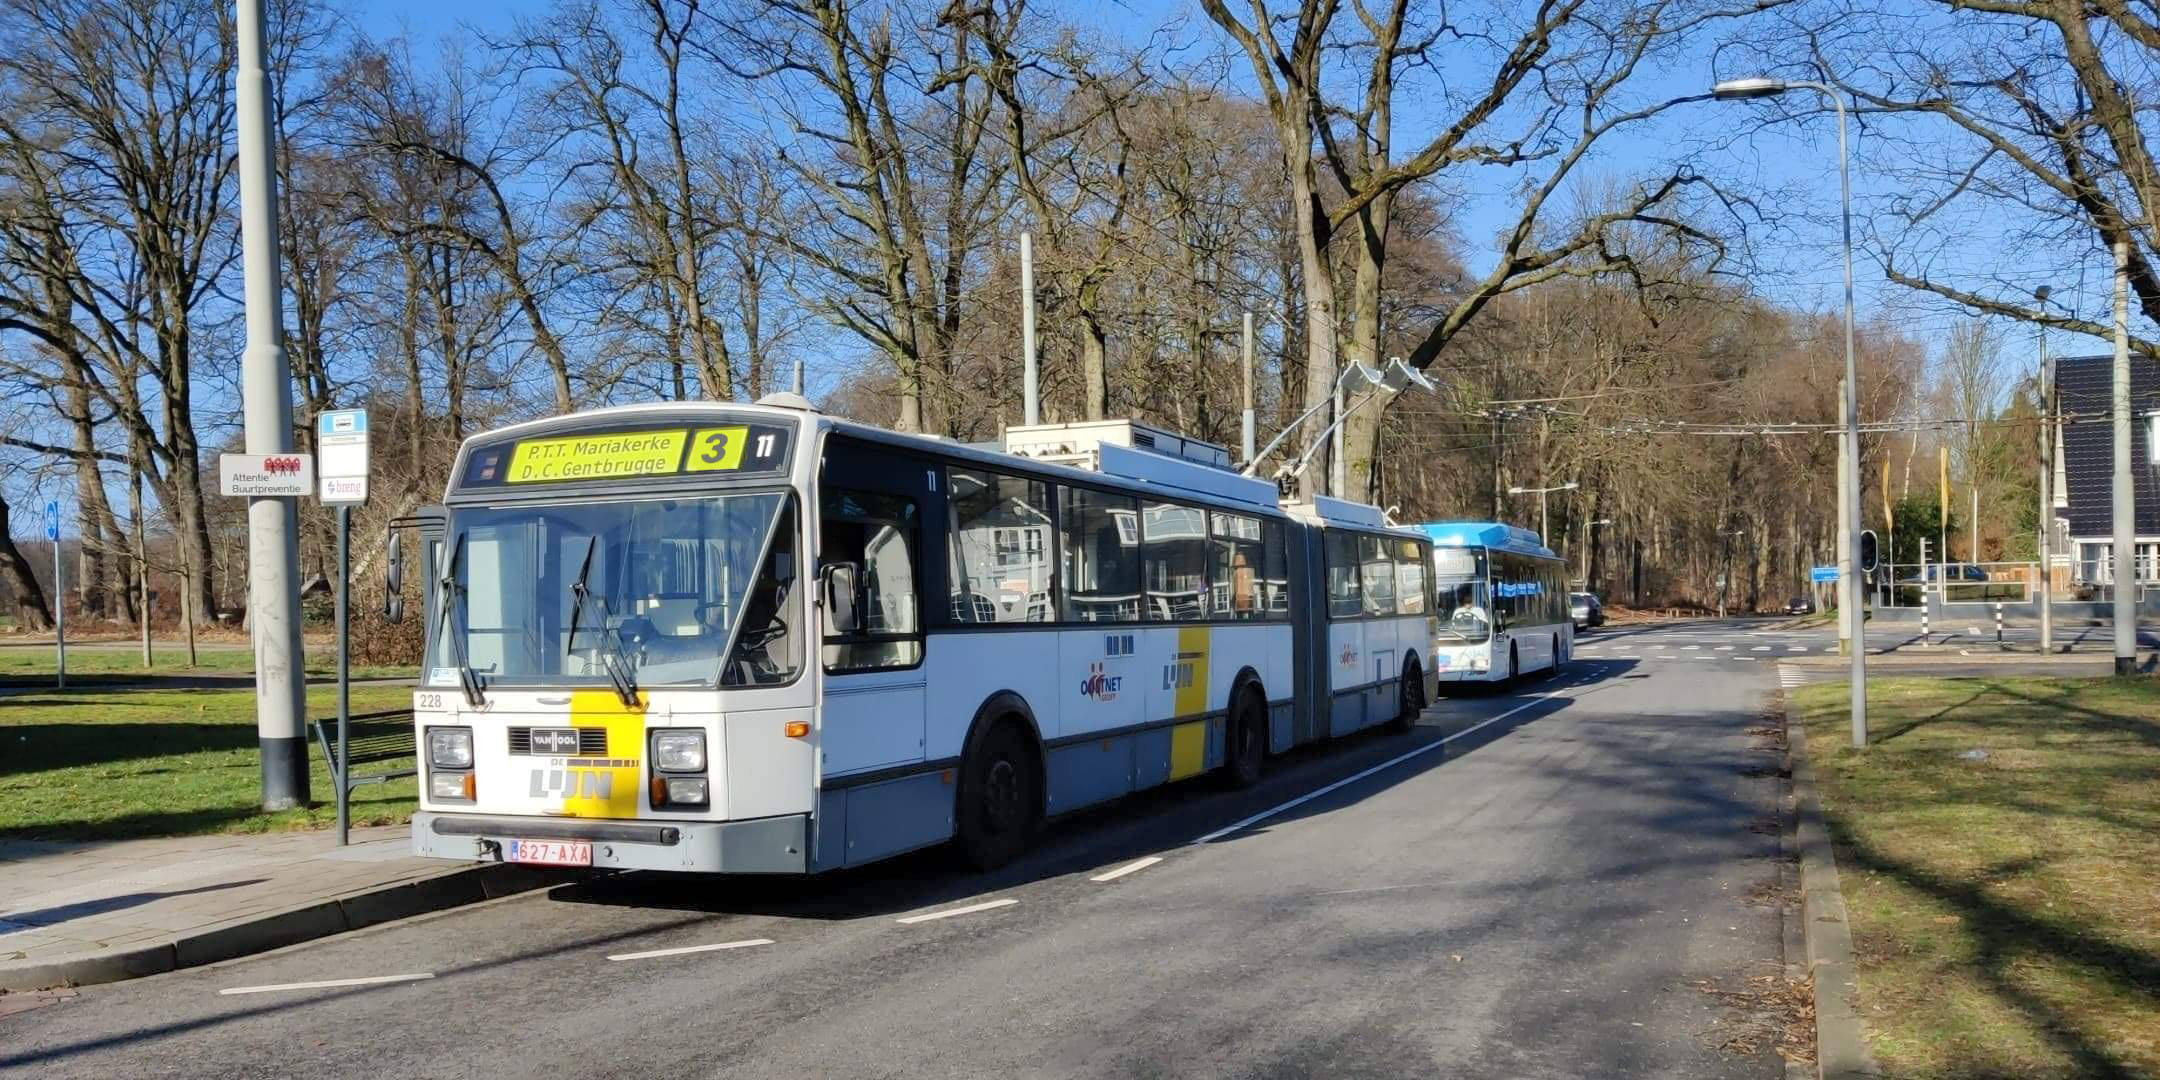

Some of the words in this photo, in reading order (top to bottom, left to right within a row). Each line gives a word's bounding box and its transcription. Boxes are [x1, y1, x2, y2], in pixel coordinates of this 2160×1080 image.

[528, 444, 567, 460] P.T.T.
[573, 436, 671, 455] Mariakerke
[701, 433, 729, 464] 3
[756, 435, 775, 457] 11
[232, 473, 269, 482] Attentie
[927, 470, 937, 492] 11
[232, 485, 301, 495] Buurtpreventie
[420, 694, 441, 708] 228
[519, 843, 588, 862] 627-AXA
